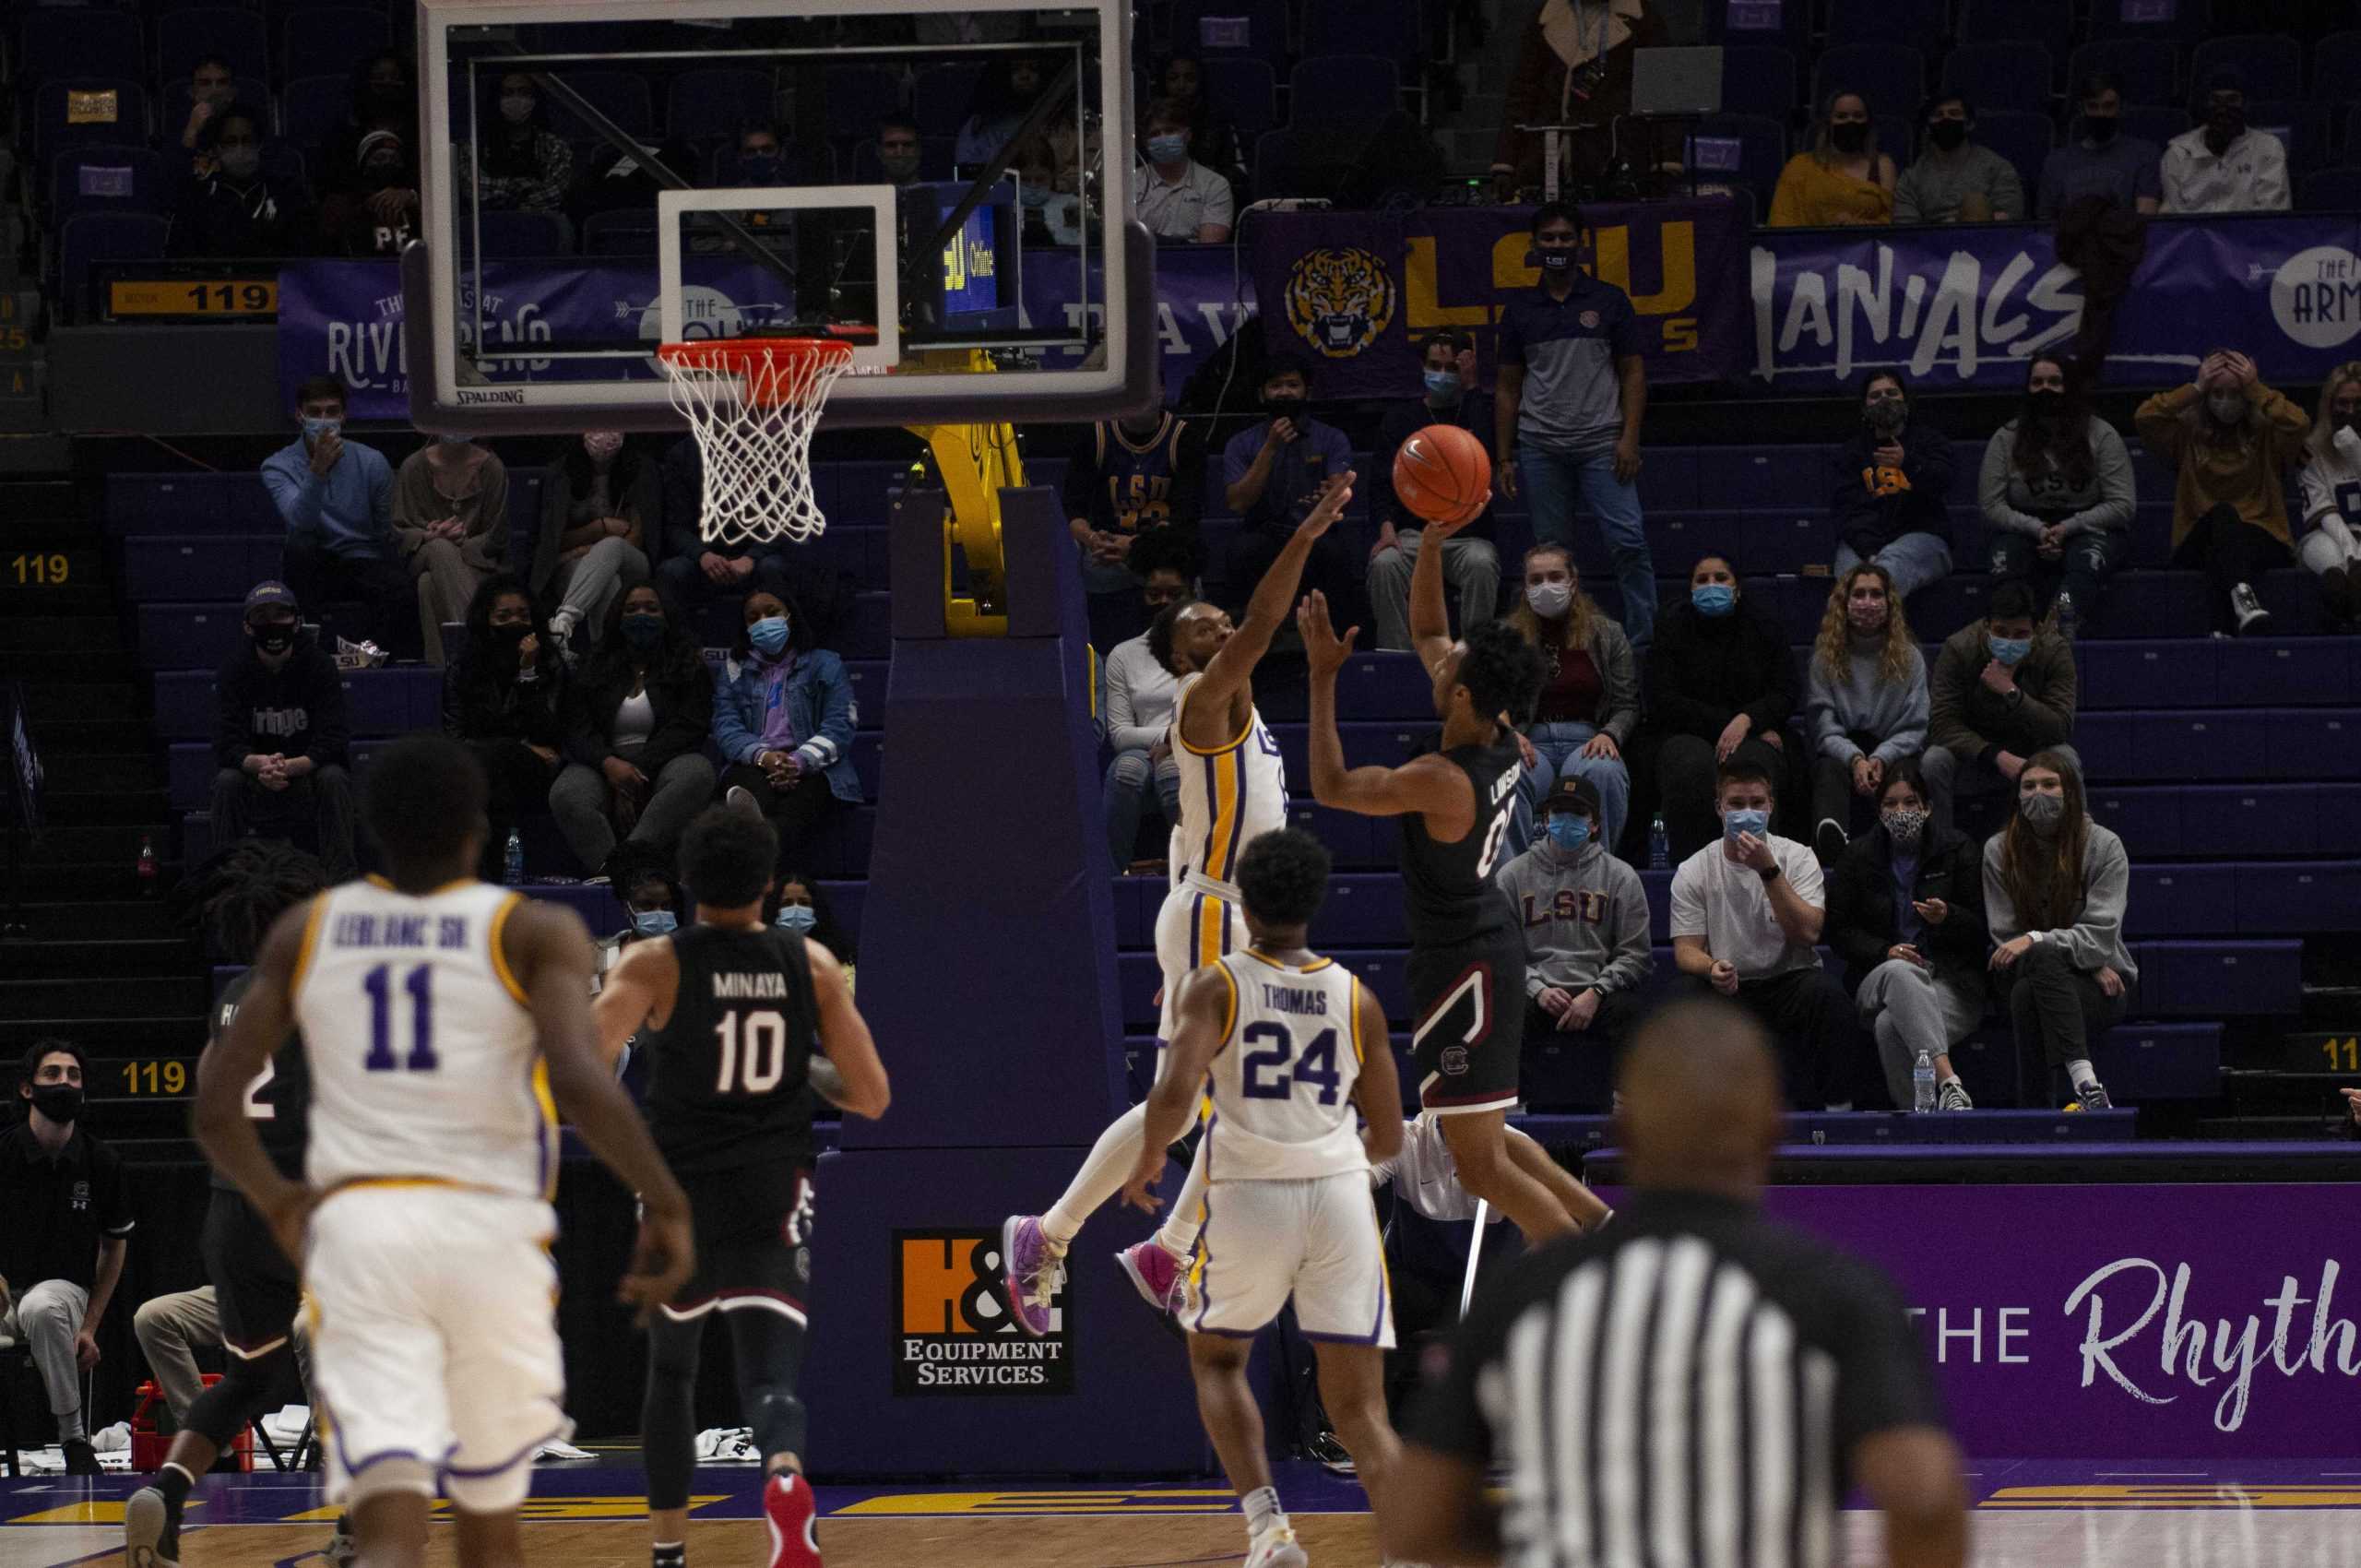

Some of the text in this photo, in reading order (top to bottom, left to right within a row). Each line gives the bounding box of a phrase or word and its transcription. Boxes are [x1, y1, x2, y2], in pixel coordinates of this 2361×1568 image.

[2317, 258, 2347, 279] THE
[187, 284, 269, 311] 119
[686, 299, 717, 317] THE
[457, 387, 524, 405] SPALDING
[12, 553, 69, 584] 119
[1522, 886, 1609, 927] LSU
[712, 970, 789, 998] MINAYA
[1262, 982, 1327, 1016] THOMAS
[363, 961, 441, 1071] 11
[713, 1009, 788, 1093] 10
[1241, 1020, 1340, 1106] 24
[121, 1060, 186, 1094] 119
[903, 1338, 1063, 1361] EQUIPMENT
